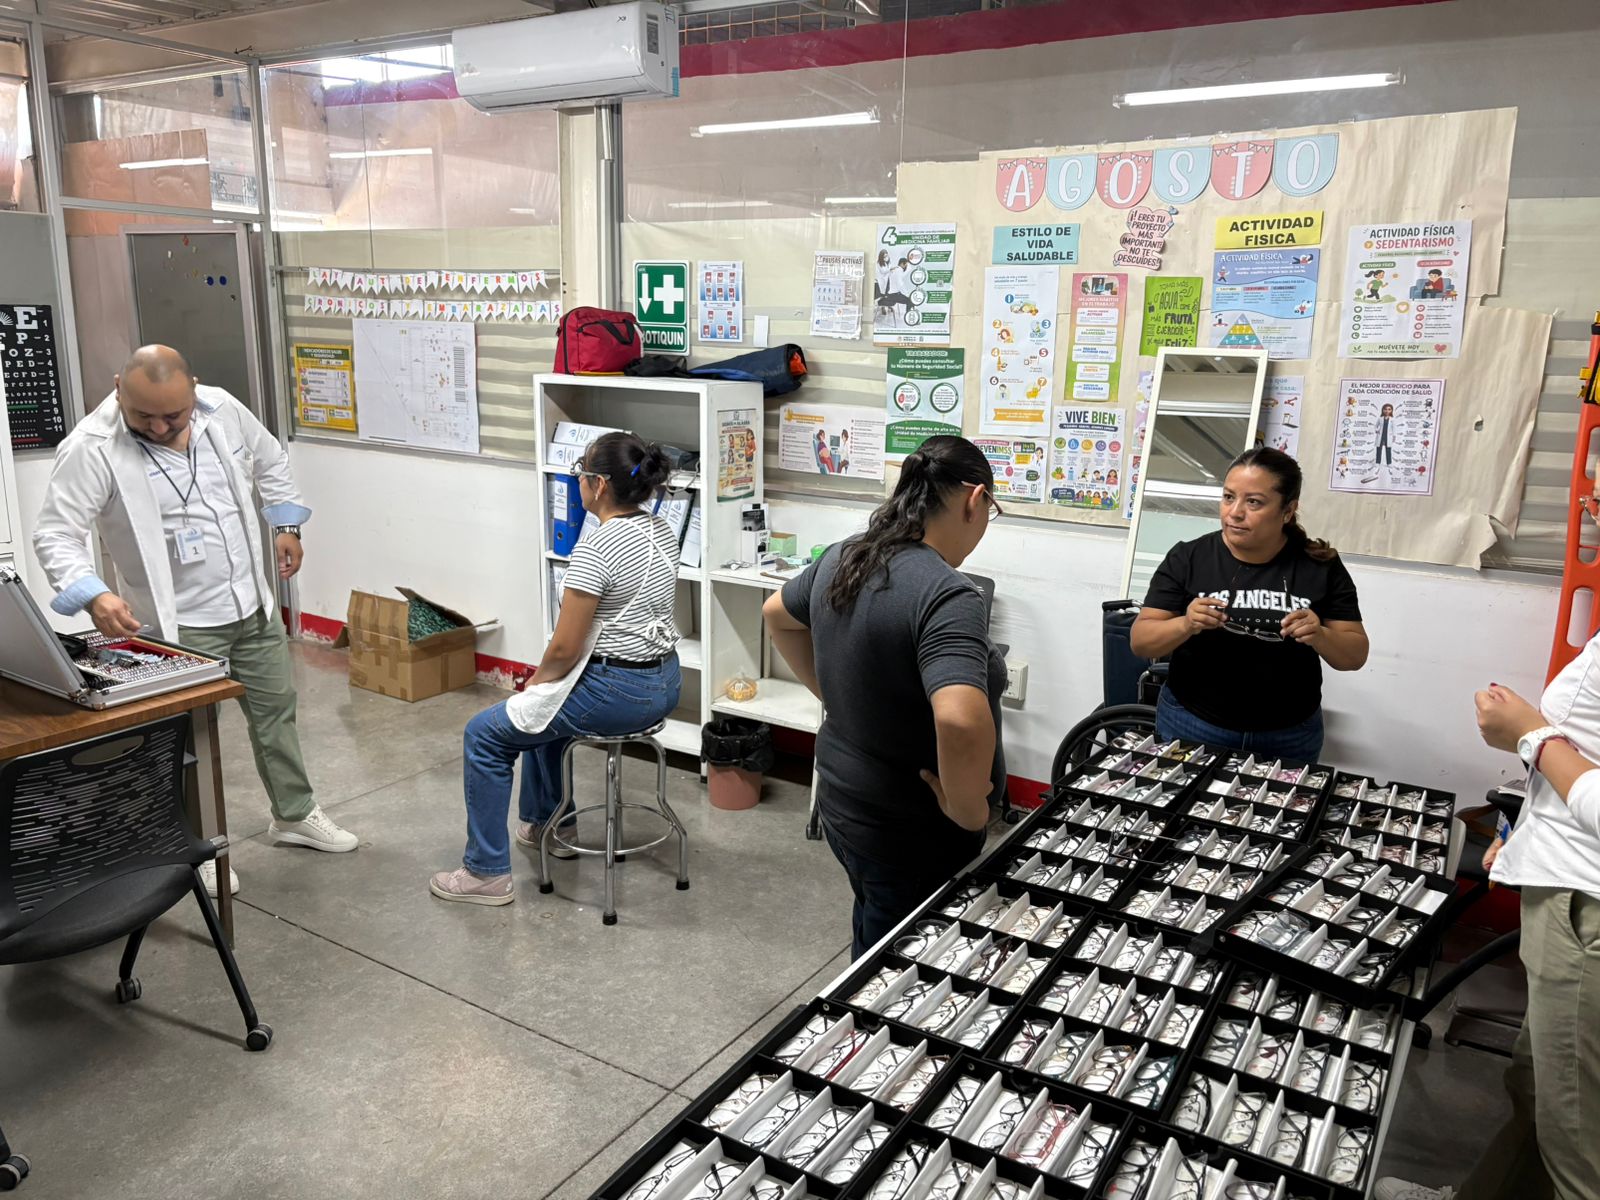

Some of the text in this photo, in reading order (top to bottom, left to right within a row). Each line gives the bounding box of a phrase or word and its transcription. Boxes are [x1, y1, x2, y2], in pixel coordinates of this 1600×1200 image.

[1006, 139, 1320, 208] AGOSTO
[1138, 213, 1155, 222] ERES
[1156, 215, 1166, 223] TU
[1131, 221, 1166, 232] PROYECTO
[1229, 216, 1314, 233] ACTIVIDAD
[881, 226, 898, 246] 4
[1011, 227, 1071, 238] ESTILO DE
[1138, 229, 1154, 239] MÁS
[1370, 225, 1455, 239] ACTIVIDAD FÍSICA
[1027, 239, 1053, 250] VIDA
[1121, 237, 1163, 248] IMPORTANTE
[1244, 232, 1296, 246] FISICA
[1375, 237, 1454, 249] SEDENTARISMO
[1006, 250, 1074, 262] SALUDABLE
[1129, 247, 1151, 257] NO TE
[1220, 254, 1259, 262] ACTIVIDAD
[308, 297, 385, 309] CRONICOS
[427, 303, 560, 313] EMBARAZADAS
[1159, 291, 1179, 310] AGUA
[13, 306, 48, 330] E 1
[16, 332, 50, 345] P 2
[9, 348, 51, 357] O Z 3
[5, 360, 12, 368] P
[16, 360, 24, 368] E
[48, 370, 54, 378] 5
[53, 407, 59, 415] 9
[53, 416, 62, 424] 10
[1065, 411, 1116, 425] VIVE BIEN
[54, 424, 63, 432] 11
[192, 546, 199, 555] 1
[1231, 589, 1312, 612] ANGELES
